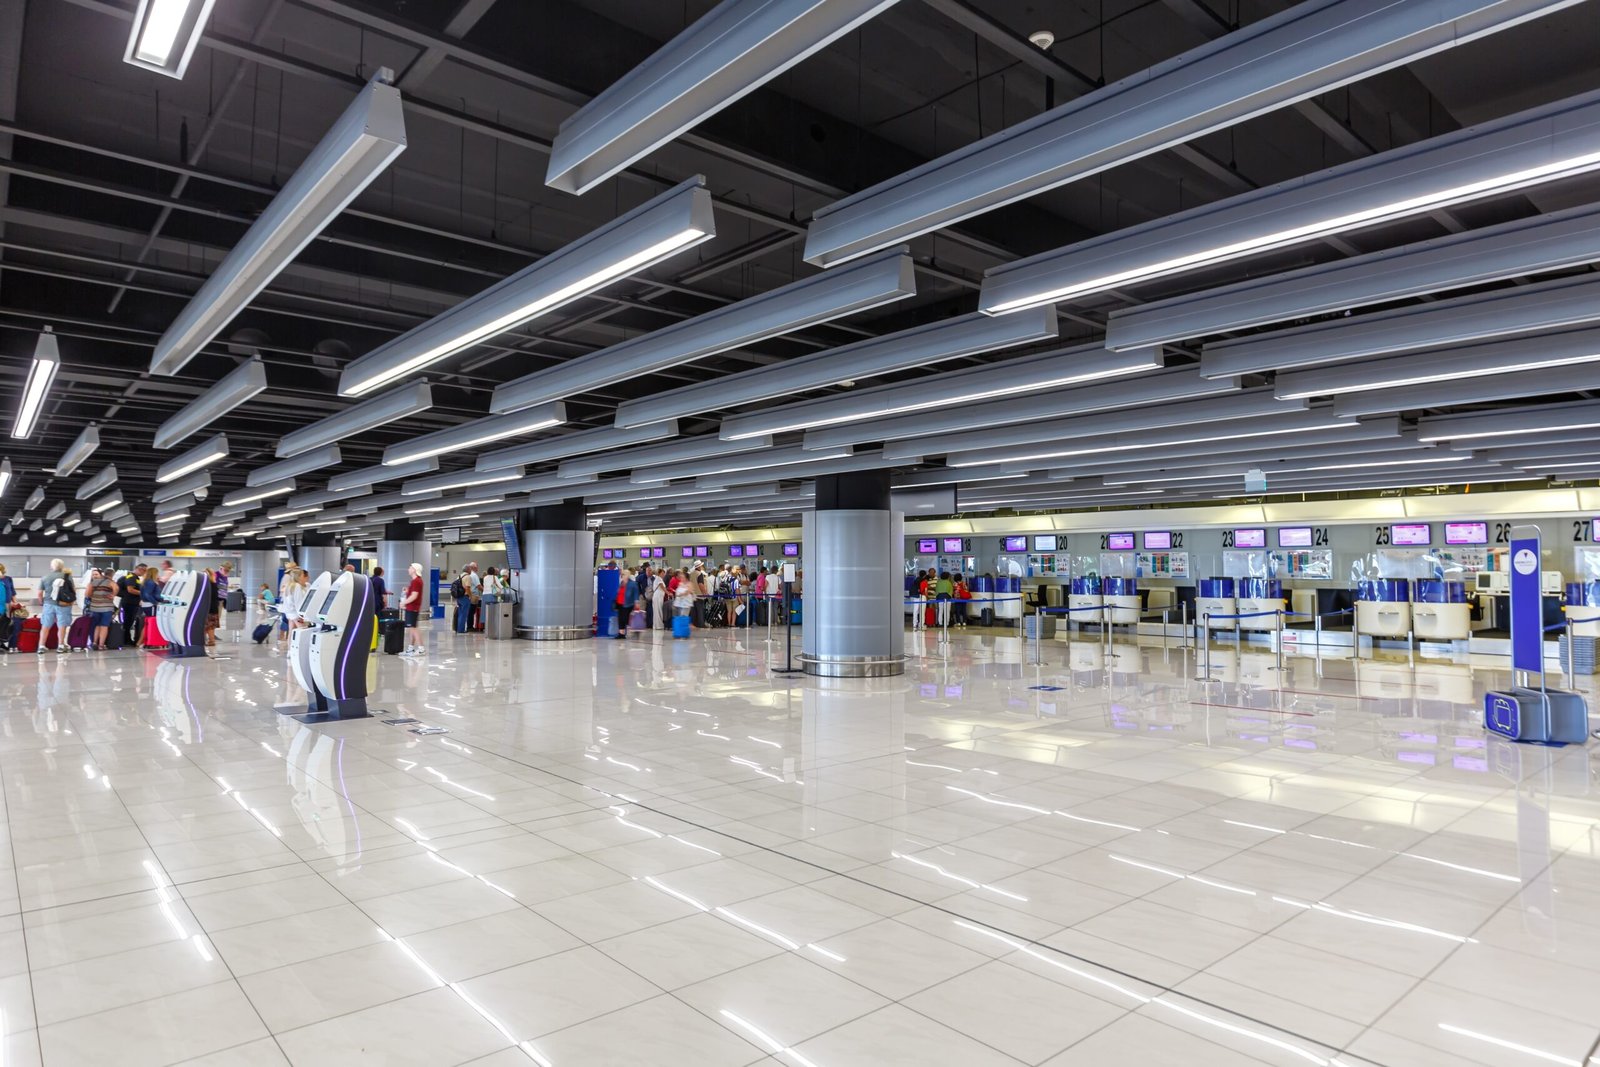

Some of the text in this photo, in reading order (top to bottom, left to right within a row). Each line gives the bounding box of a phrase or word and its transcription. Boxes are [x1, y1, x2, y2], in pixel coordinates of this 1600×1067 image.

[1316, 528, 1328, 546] 24
[1376, 527, 1389, 545] 25
[1496, 523, 1510, 542] 26
[1574, 521, 1590, 541] 27
[965, 539, 971, 552] 18
[999, 538, 1006, 551] 19
[1059, 536, 1068, 550] 20
[1100, 535, 1109, 550] 21
[1172, 533, 1182, 548] 22
[1222, 531, 1234, 547] 23
